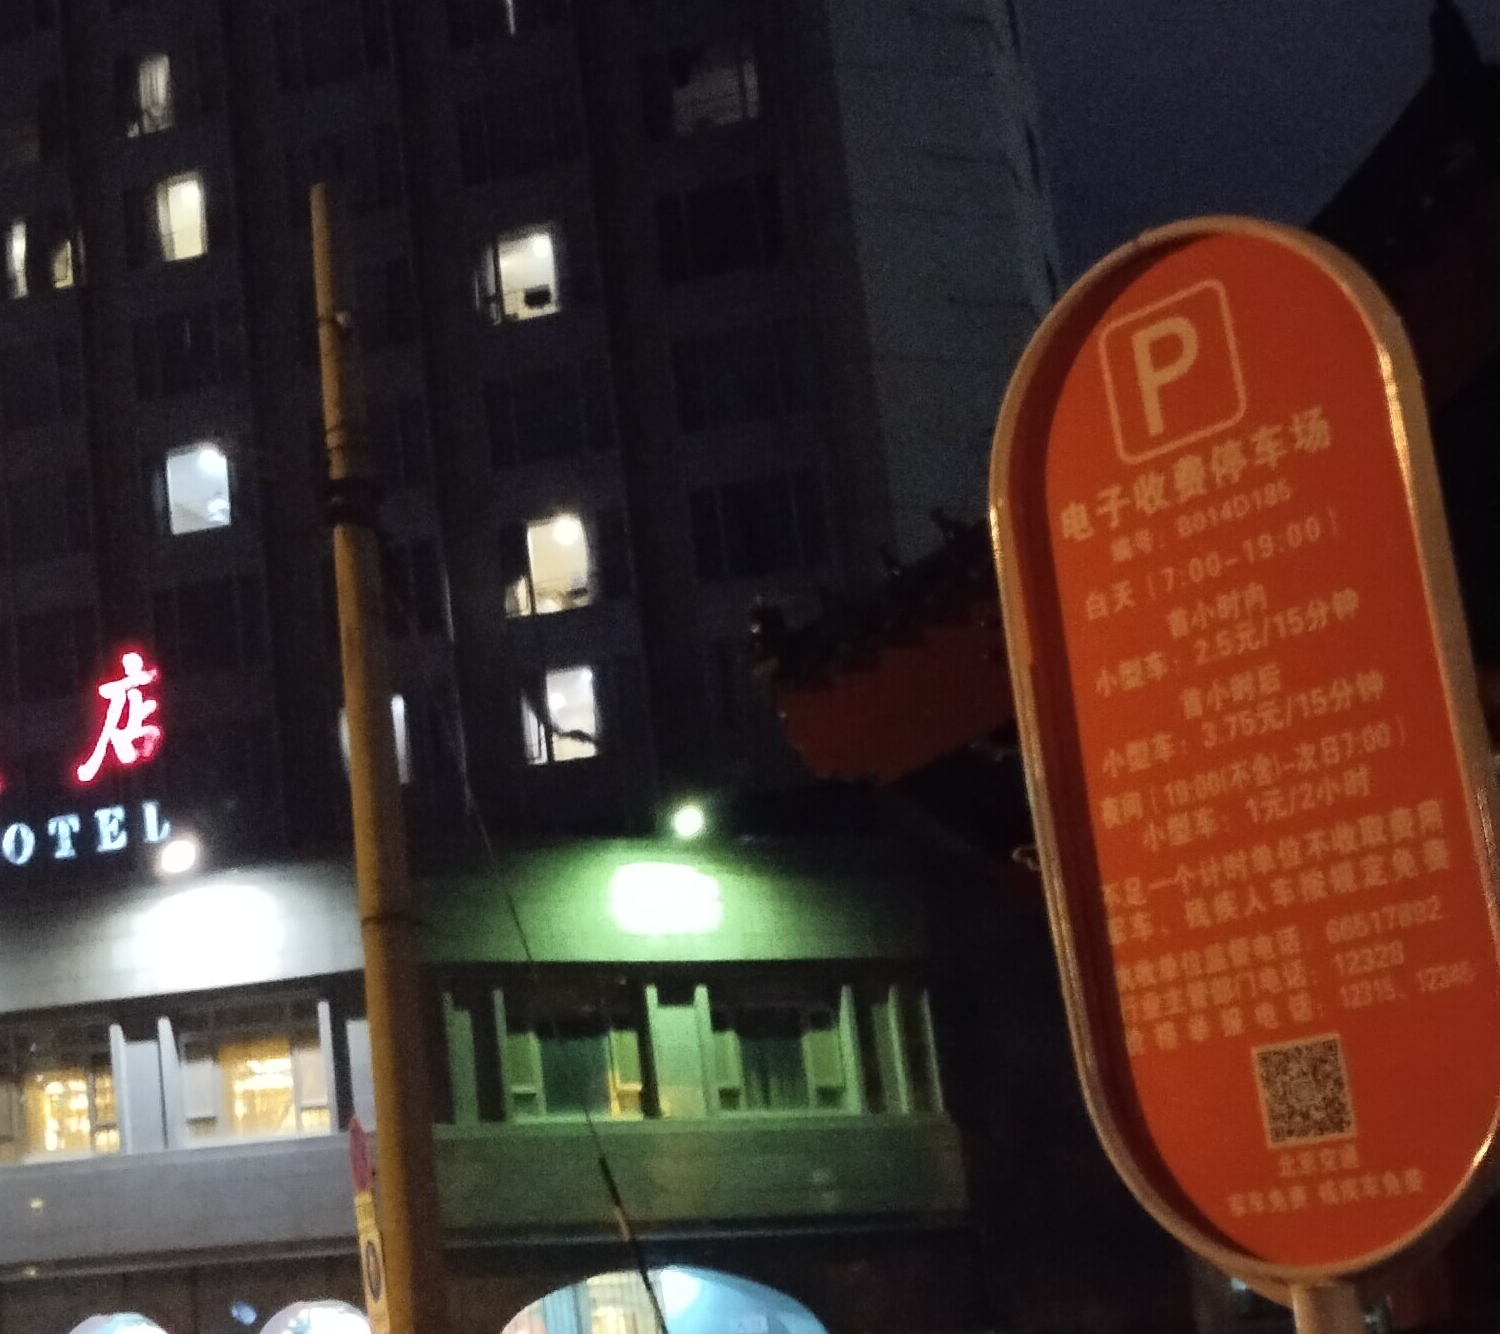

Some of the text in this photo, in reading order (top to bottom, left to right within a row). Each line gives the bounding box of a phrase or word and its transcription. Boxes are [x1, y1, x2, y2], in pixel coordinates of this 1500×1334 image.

[1130, 316, 1199, 435] P
[1059, 406, 1332, 542] 电子收费停车场
[1166, 582, 1269, 640] 首小时内
[1180, 663, 1282, 720] 首小时后
